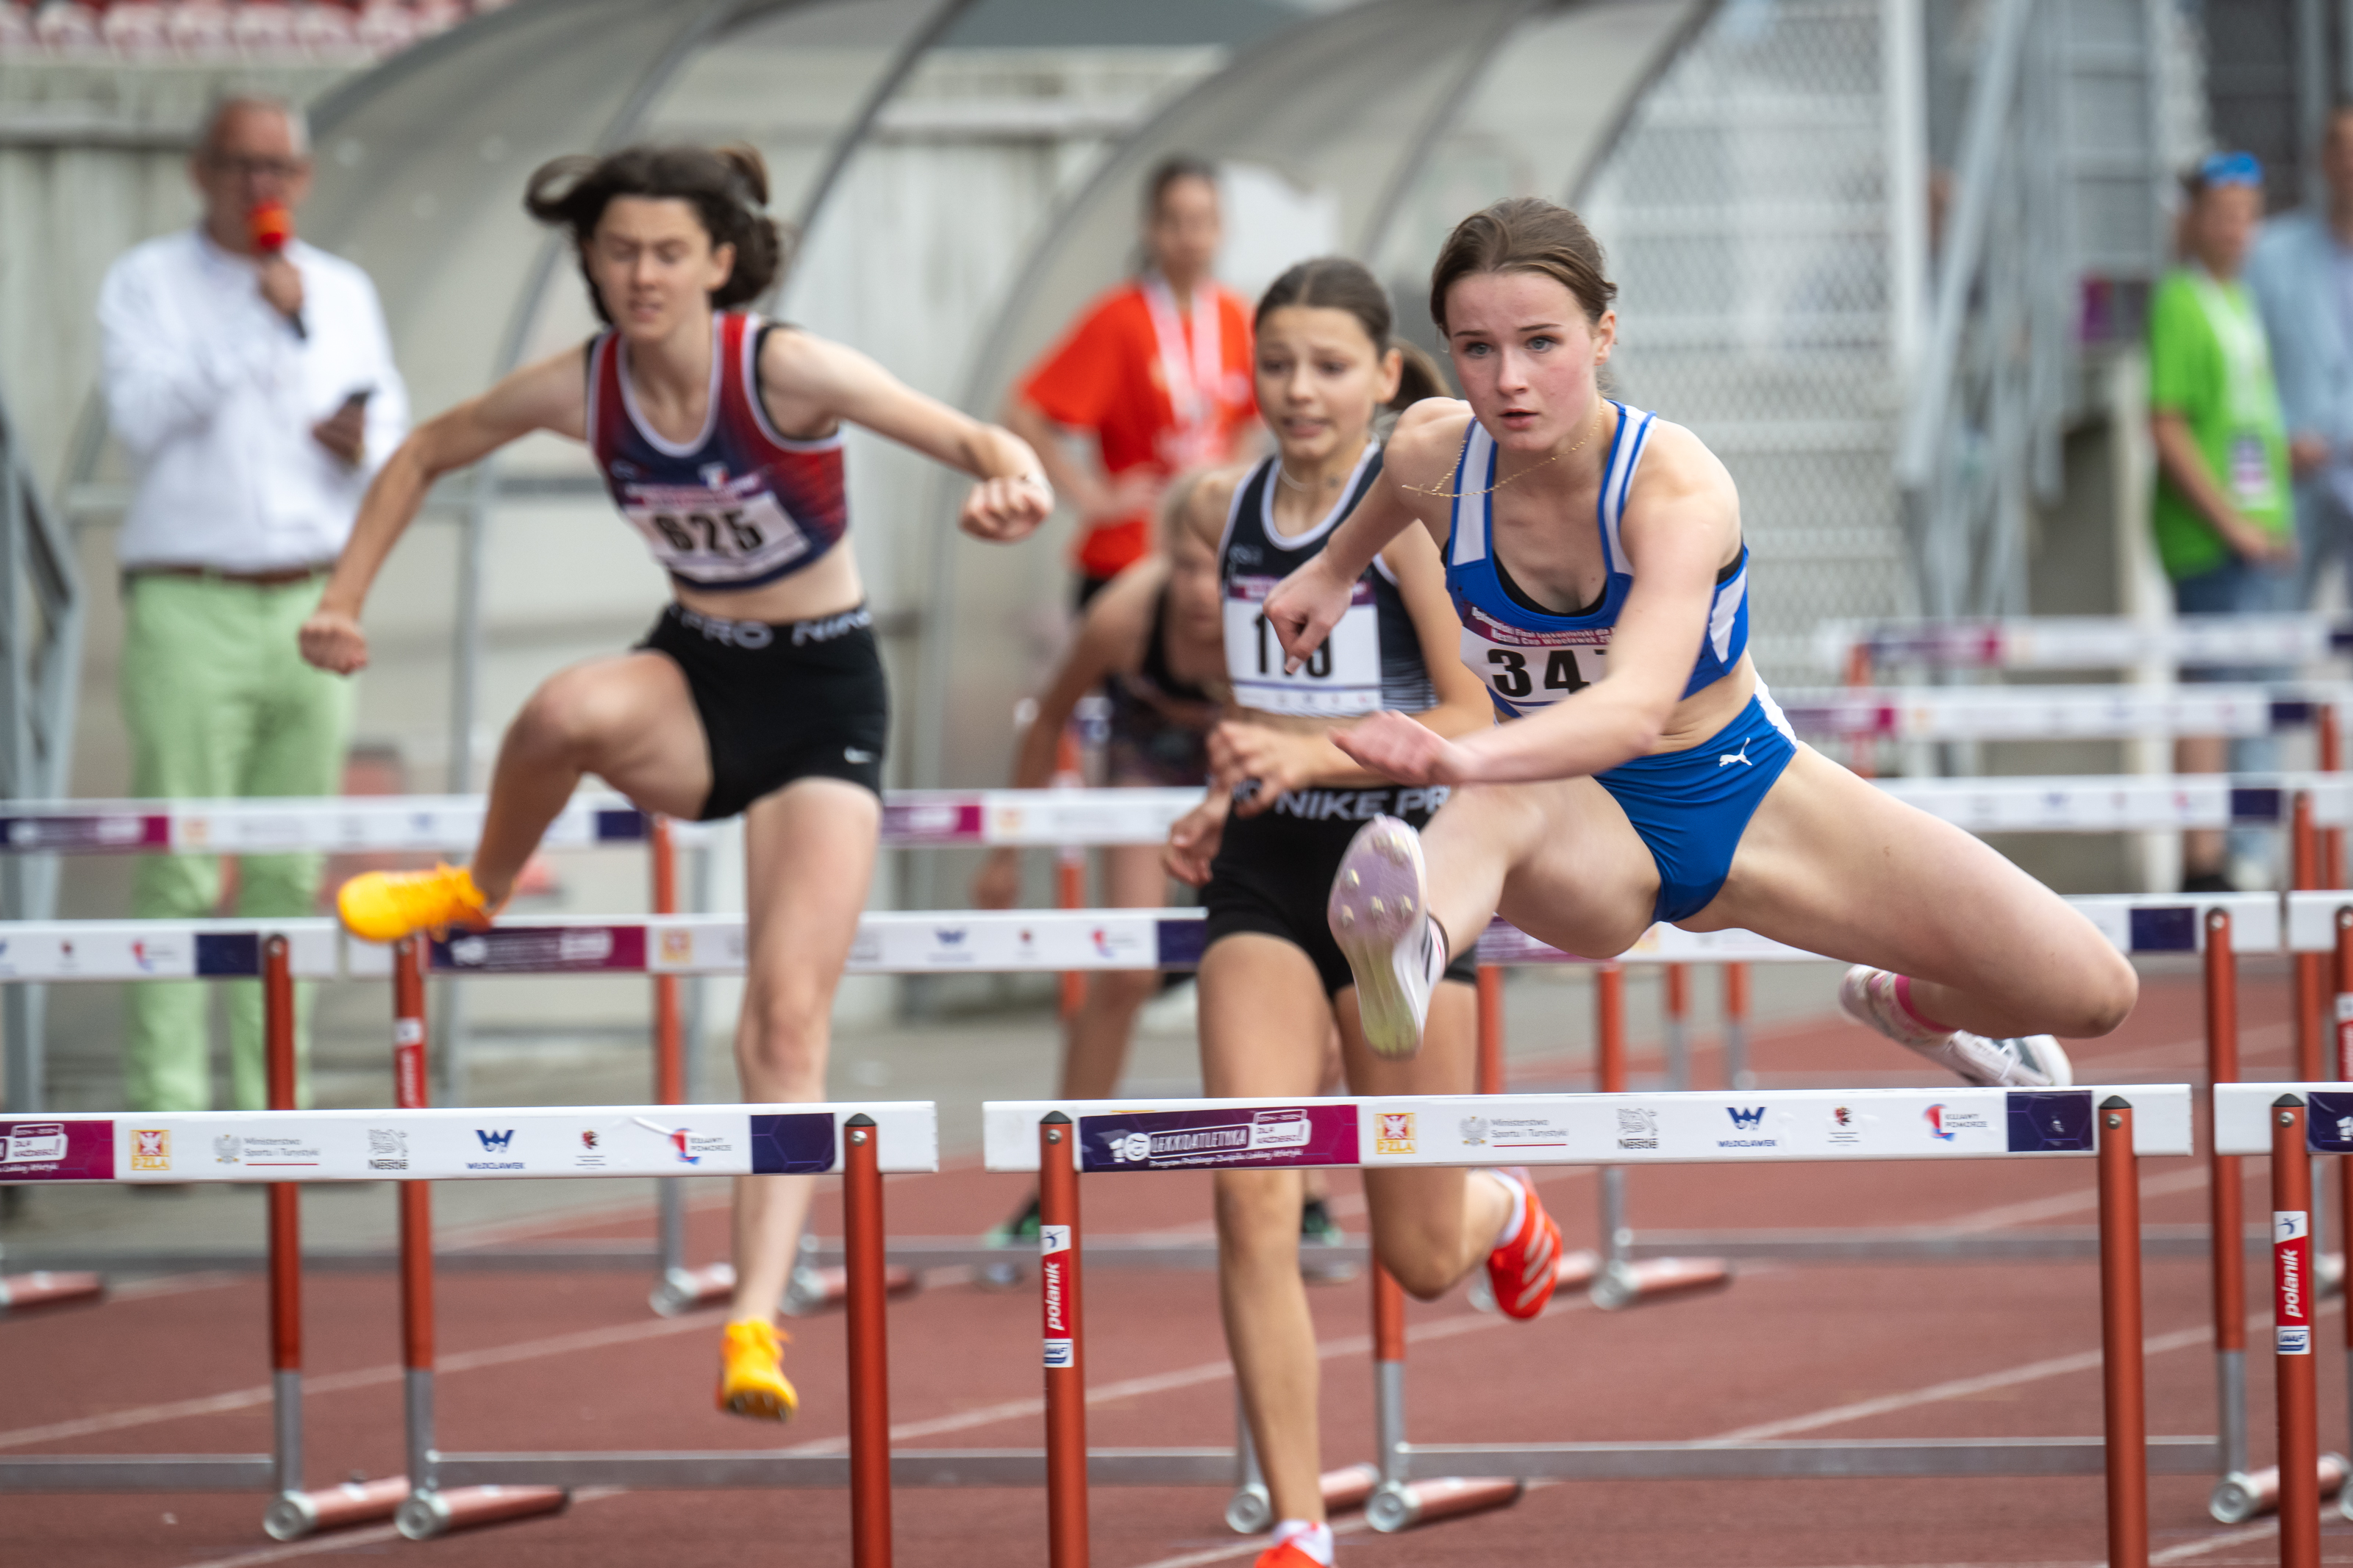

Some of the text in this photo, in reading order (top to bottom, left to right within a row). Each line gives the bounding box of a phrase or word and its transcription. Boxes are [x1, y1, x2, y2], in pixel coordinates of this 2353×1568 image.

[654, 509, 763, 557] 625
[1488, 648, 1607, 697] 34
[1274, 785, 1451, 820] NIKE PR
[1490, 1118, 1549, 1126] Ministerstwo
[1491, 1129, 1520, 1138] Sportu
[1528, 1128, 1568, 1138] Turystyki
[244, 1137, 302, 1145] Ministerstwo
[245, 1148, 272, 1156] Sportu
[1044, 1261, 1065, 1331] polanik
[2280, 1248, 2304, 1318] polanik
